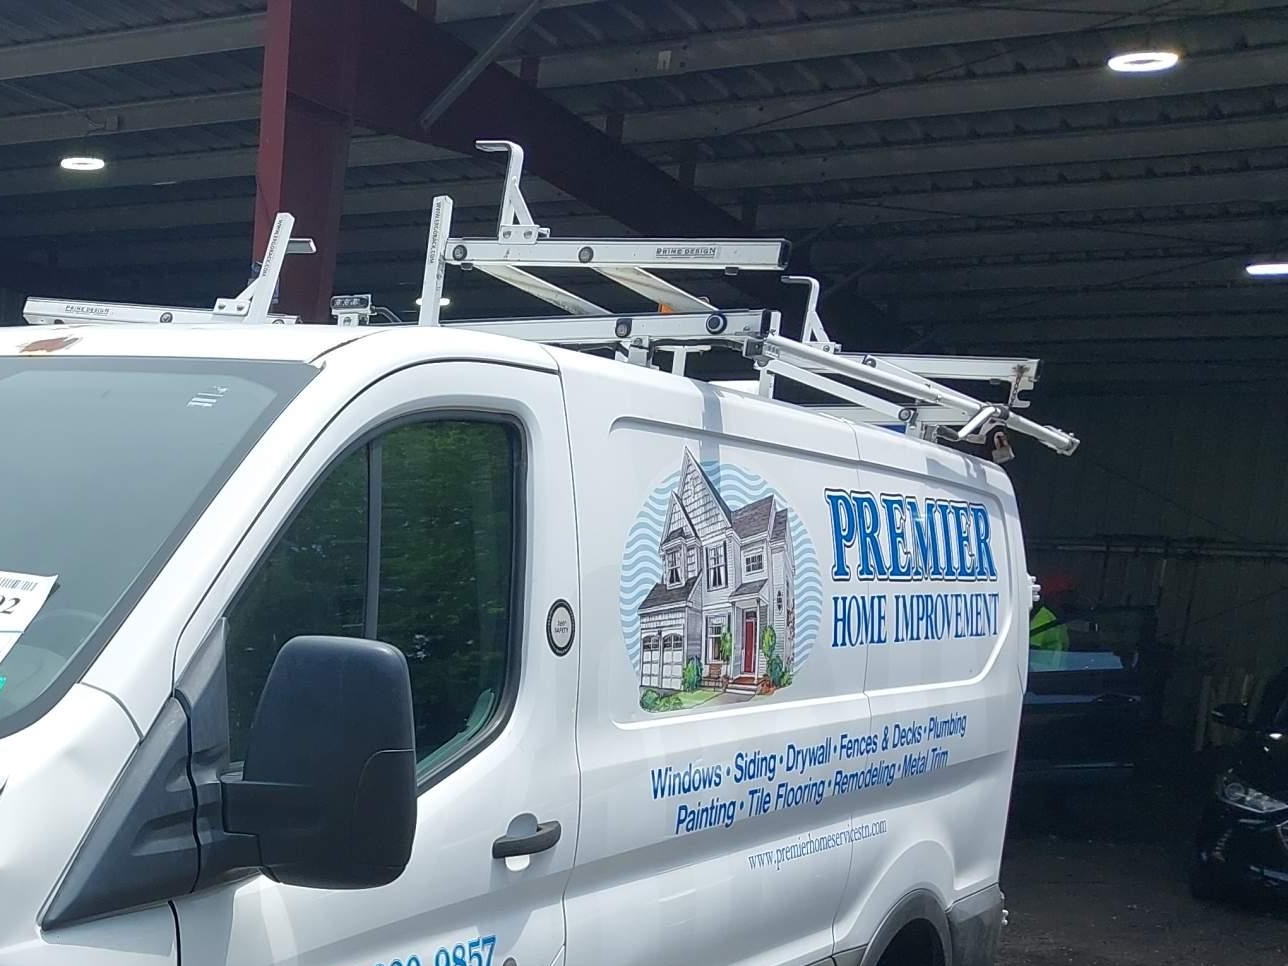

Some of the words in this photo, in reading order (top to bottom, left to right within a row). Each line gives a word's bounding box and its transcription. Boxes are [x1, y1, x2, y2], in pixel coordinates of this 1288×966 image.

[684, 247, 716, 256] DESIGN
[86, 306, 110, 315] DESIGN
[825, 488, 998, 582] PREMIER
[832, 595, 887, 647] HOME
[894, 592, 1000, 642] IMPROVEMENT
[651, 763, 722, 799] Windows
[734, 751, 776, 782] Siding
[785, 737, 832, 774] Drywall
[839, 734, 878, 760] Fences
[882, 726, 889, 751] &
[892, 723, 923, 749] Decks
[927, 713, 967, 740] Plumbing
[675, 798, 736, 835] Painting
[748, 788, 772, 817] Tile
[775, 777, 825, 811] Flooring
[832, 760, 896, 796] Remodeling
[901, 749, 928, 779] Metal
[929, 747, 949, 772] Trim
[748, 819, 888, 871] www.premierhomeservicestn.com
